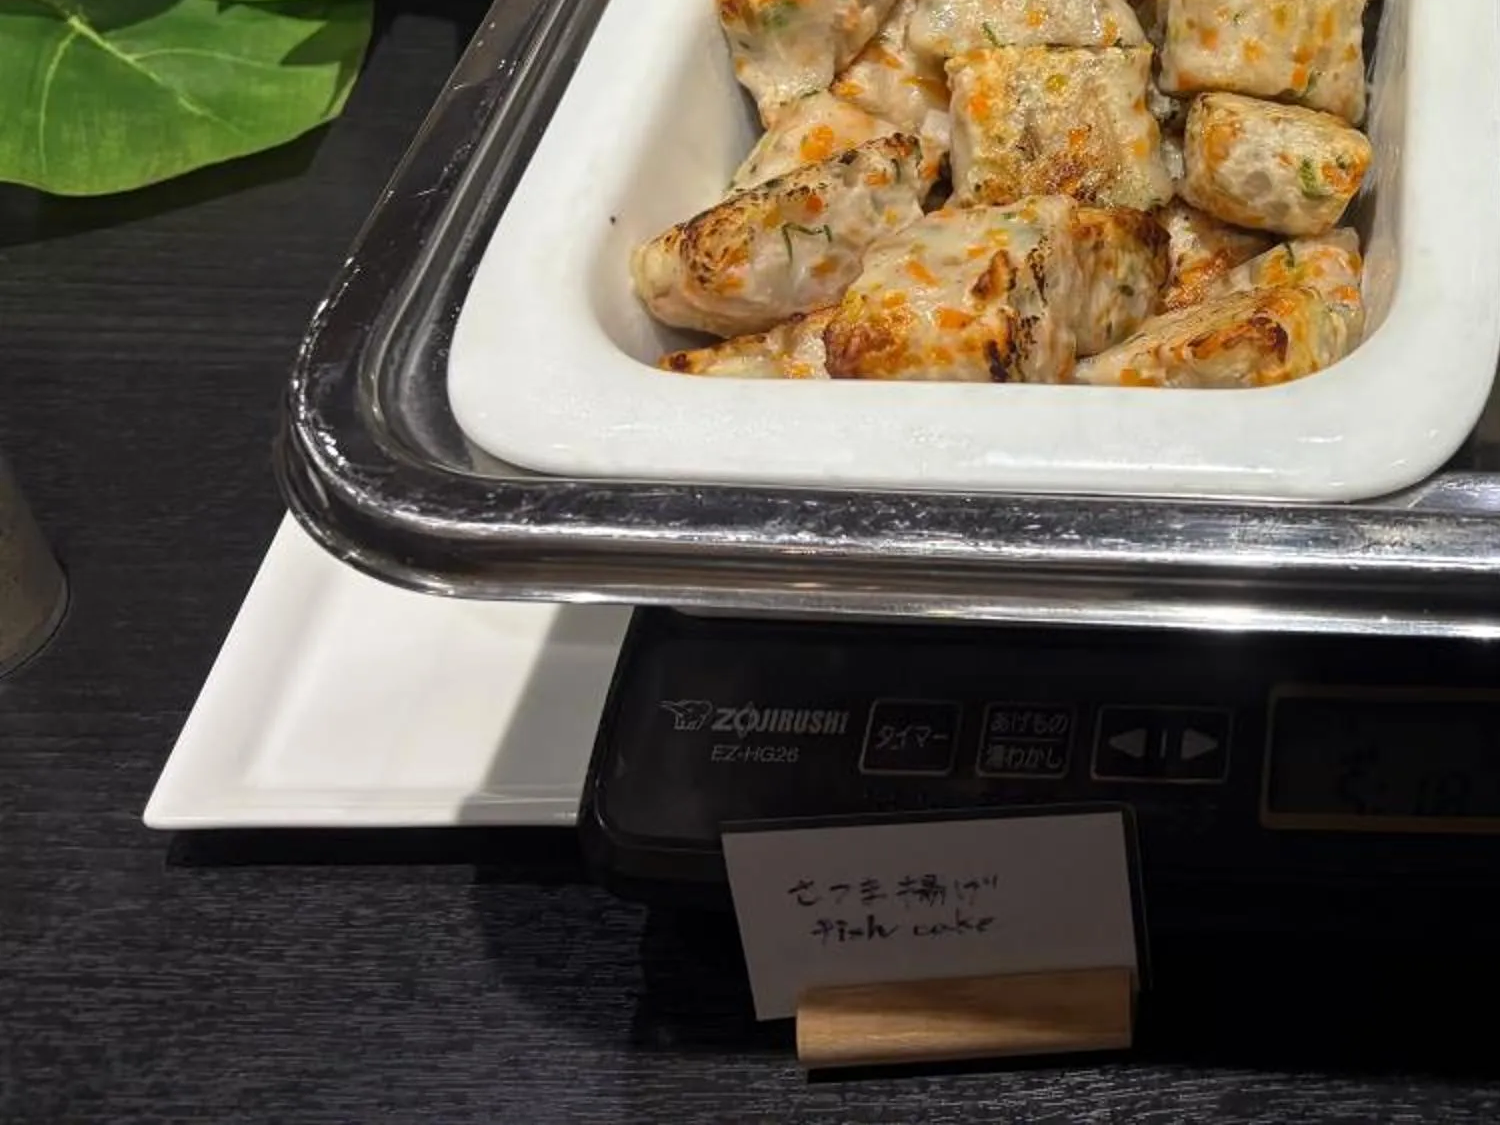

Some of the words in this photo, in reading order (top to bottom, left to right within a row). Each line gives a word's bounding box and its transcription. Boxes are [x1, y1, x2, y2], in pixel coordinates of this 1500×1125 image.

[711, 701, 850, 739] ZOJIRUSHI
[990, 711, 1069, 735] あげもの
[873, 724, 950, 752] タイマー
[711, 744, 800, 763] EZ-HG26
